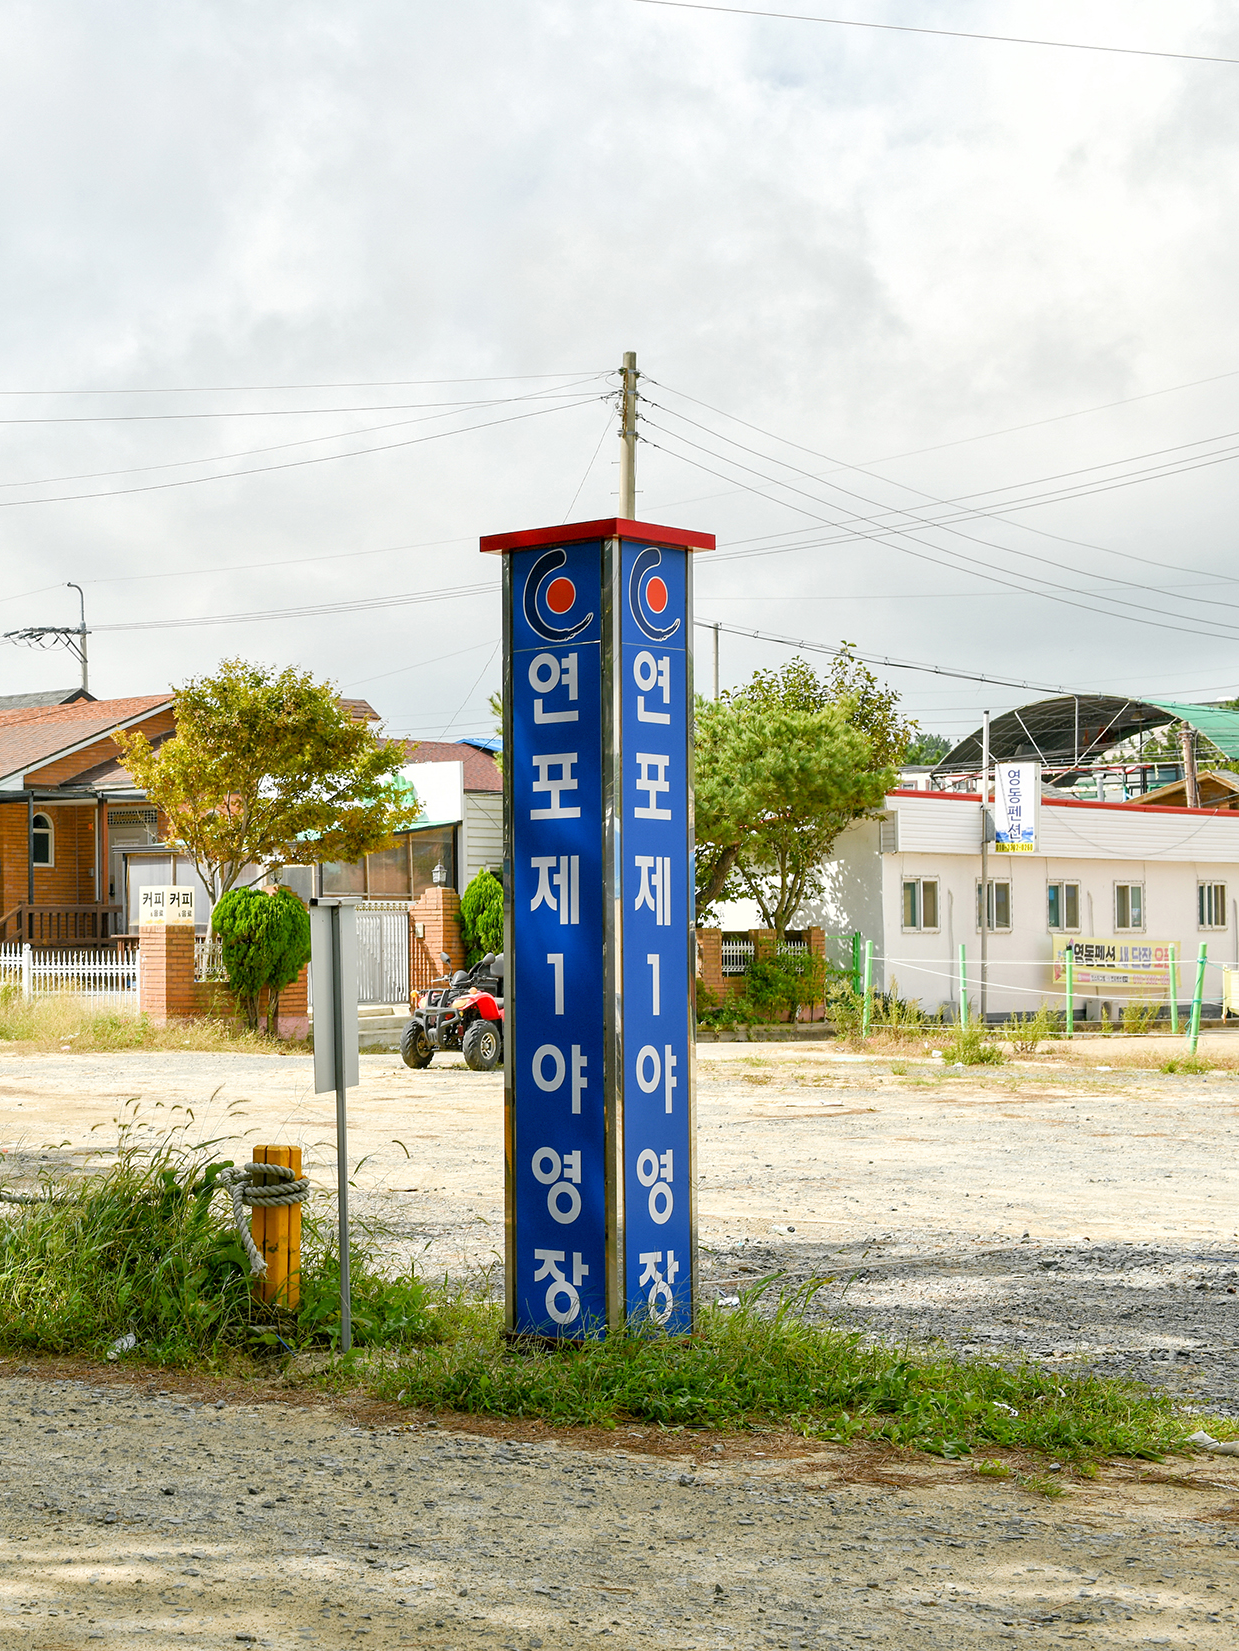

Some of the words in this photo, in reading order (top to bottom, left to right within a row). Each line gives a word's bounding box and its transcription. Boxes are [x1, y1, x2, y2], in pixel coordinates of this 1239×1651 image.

[1007, 769, 1022, 840] 영동펜션
[143, 891, 164, 907] 커피
[170, 891, 192, 907] 커피
[528, 652, 590, 1325] 연포제1야영장
[633, 650, 680, 1326] 연포제1야영장
